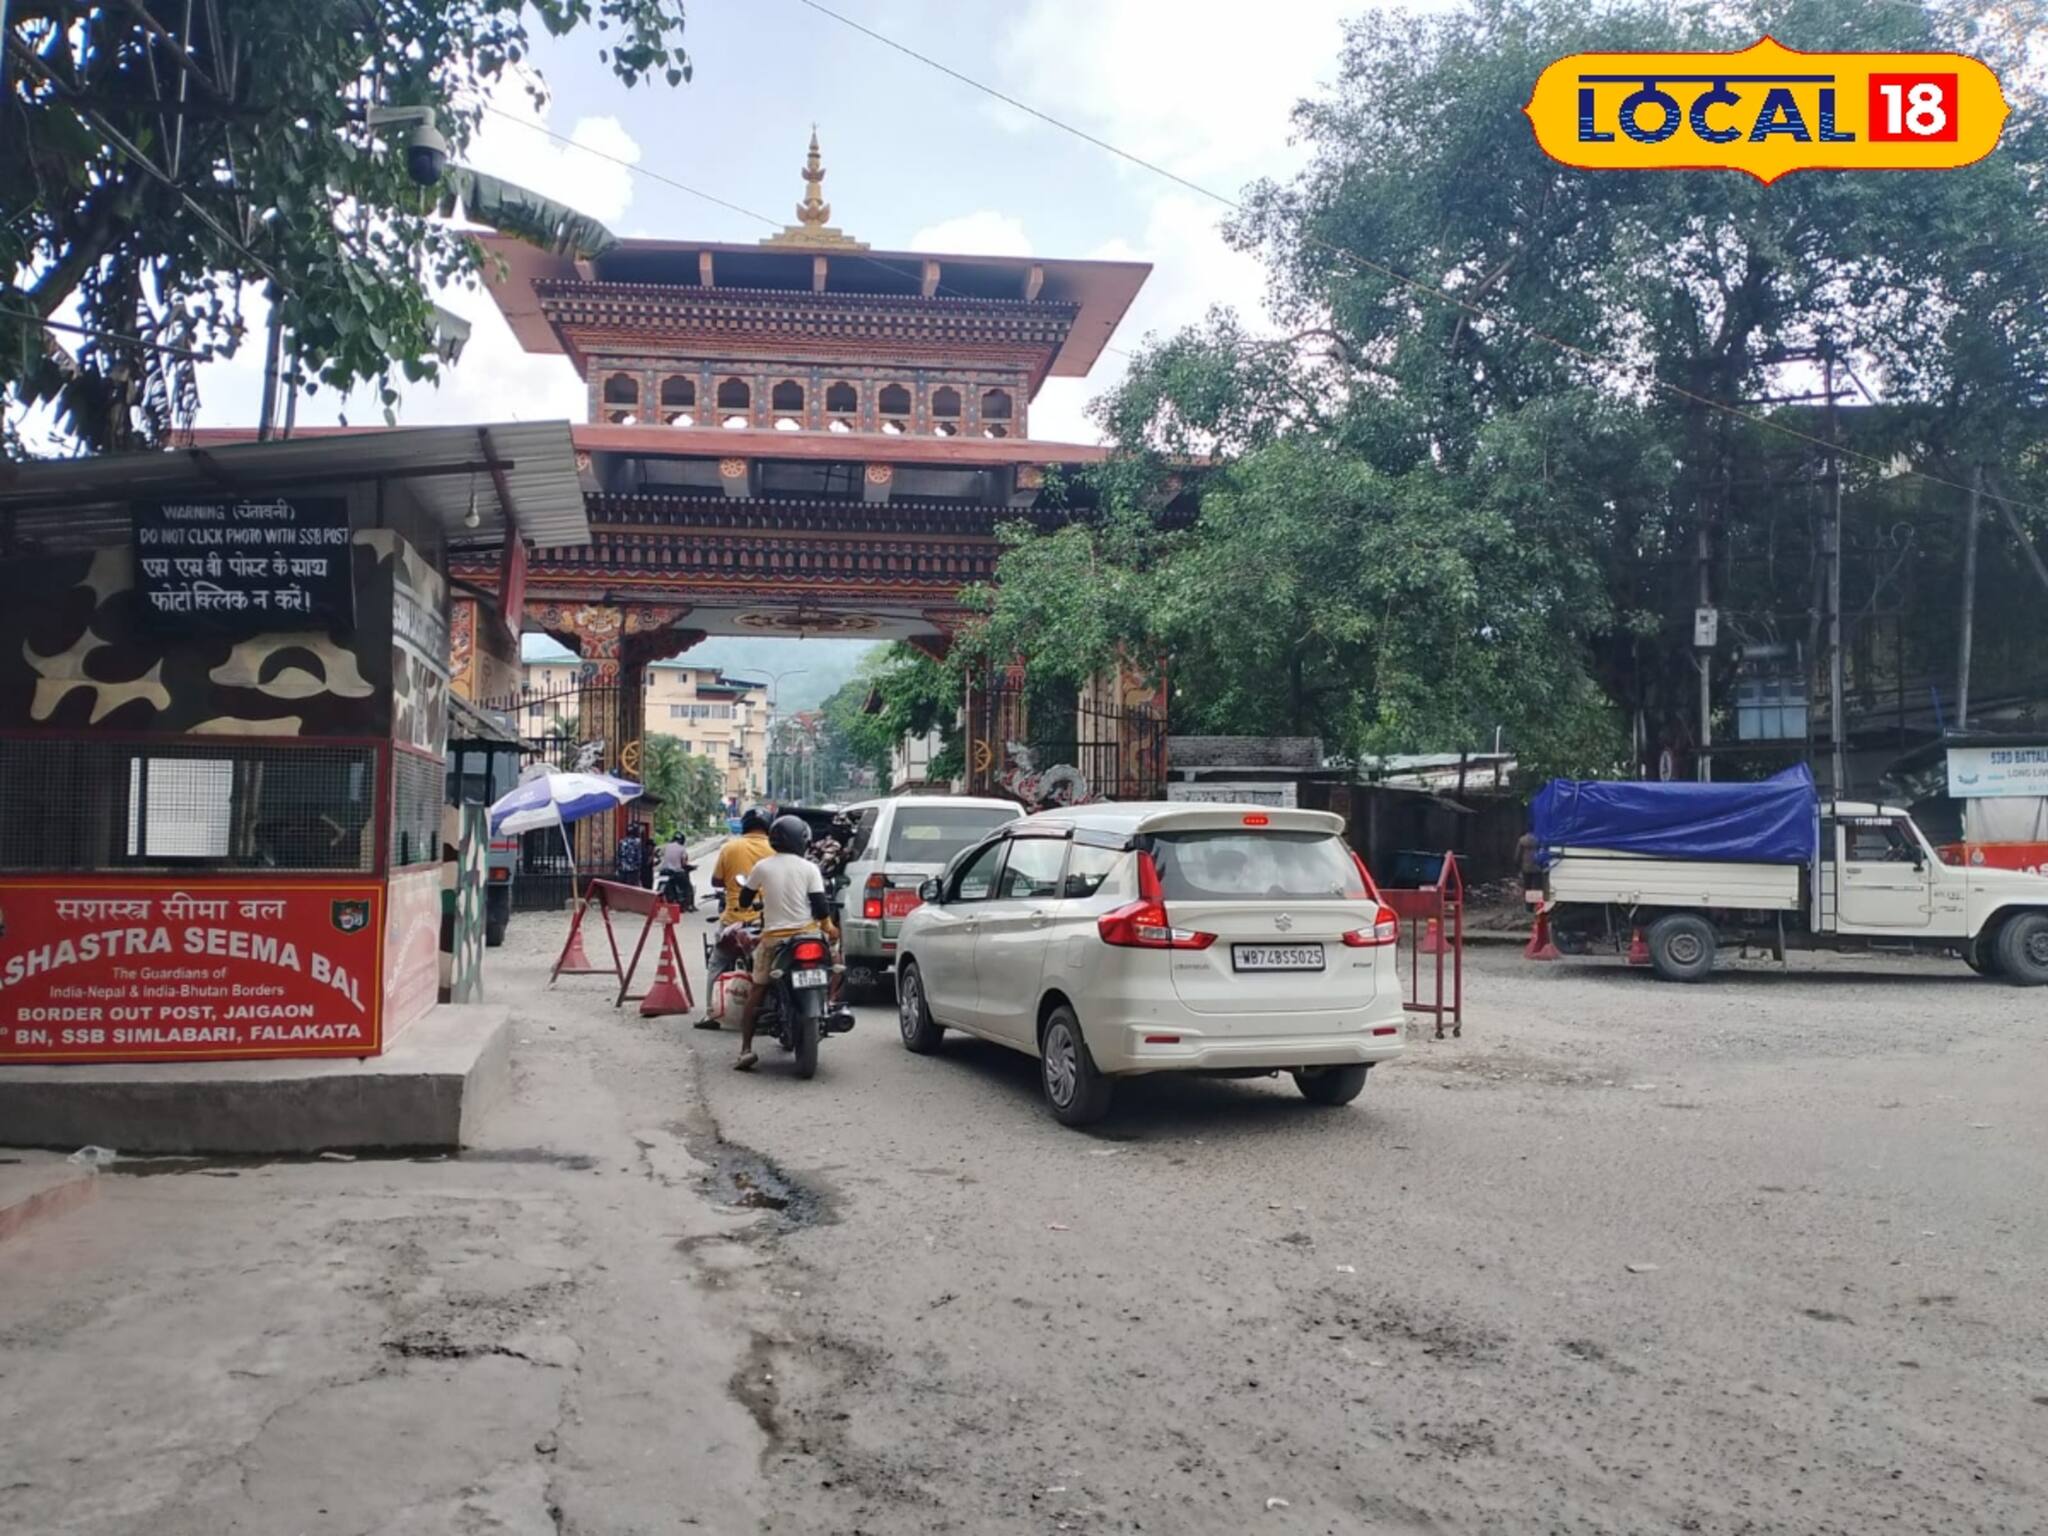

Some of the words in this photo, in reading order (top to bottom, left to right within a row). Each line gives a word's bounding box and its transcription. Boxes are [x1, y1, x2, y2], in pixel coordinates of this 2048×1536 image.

[161, 504, 225, 520] WARNING
[140, 528, 158, 544] DO
[161, 528, 185, 544] NOT
[188, 528, 223, 545] CLICK
[226, 528, 262, 544] PHOTO
[263, 528, 296, 544] WITH
[299, 528, 322, 545] SSB
[323, 528, 349, 544] POST
[141, 558, 170, 577] एस
[174, 558, 203, 577] एस
[227, 551, 269, 577] पोस्ट
[272, 551, 288, 576] के
[289, 558, 328, 577] साथ
[148, 582, 192, 612] फोटो
[251, 590, 270, 610] न
[55, 900, 152, 921] सशस्त्र
[160, 892, 229, 920] सीमा
[237, 900, 287, 920] बल
[113, 967, 137, 979] The
[141, 966, 210, 979] Guardians
[212, 966, 227, 979] of
[184, 926, 301, 972] SEEMA
[311, 952, 366, 1013] BAL
[50, 985, 126, 1000] India-Nepal
[129, 985, 138, 997] &
[143, 984, 229, 997] India-Bhutan
[232, 983, 285, 997] Borders
[17, 1007, 103, 1021] BORDER
[110, 1006, 152, 1020] OUT
[160, 1006, 217, 1021] POST,
[224, 1005, 314, 1020] JAIGAON
[15, 1029, 53, 1046] BN,
[61, 1028, 105, 1043] SSB
[112, 1027, 243, 1044] SIMLABARI,
[250, 1024, 362, 1041] FALAKATA
